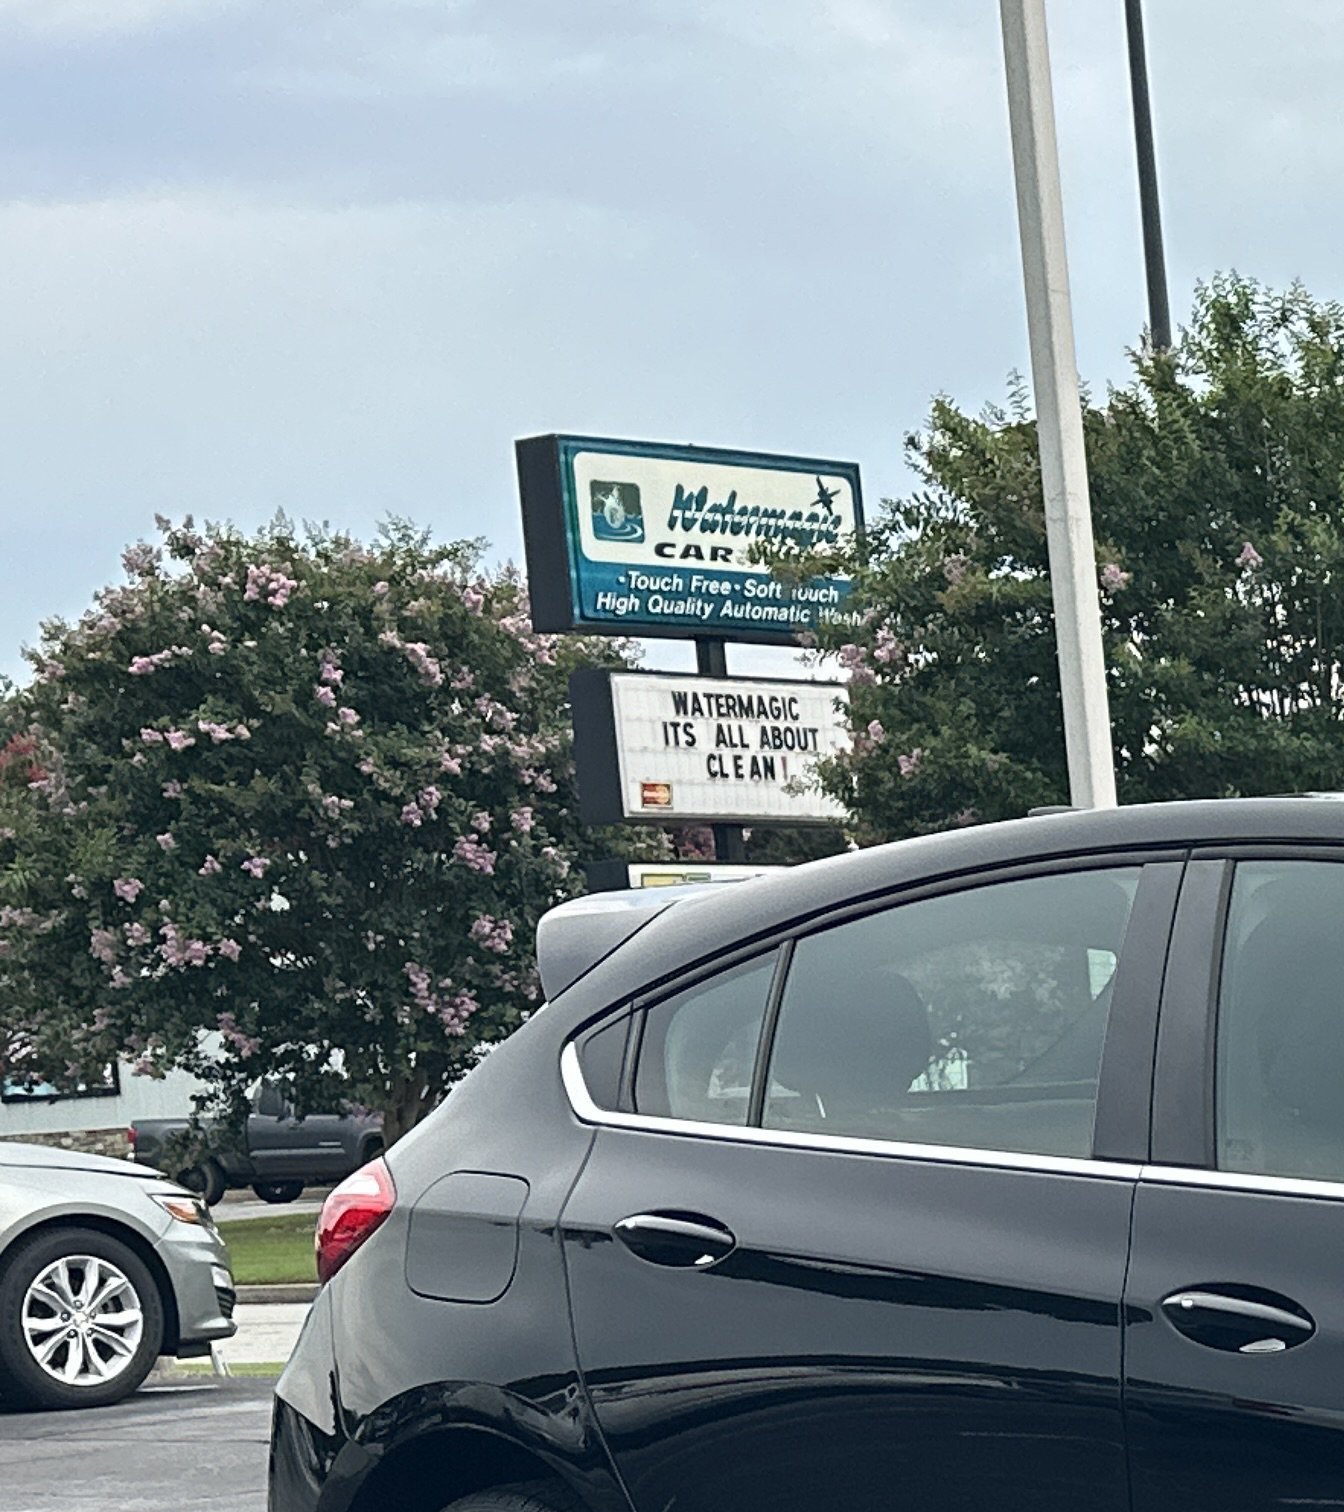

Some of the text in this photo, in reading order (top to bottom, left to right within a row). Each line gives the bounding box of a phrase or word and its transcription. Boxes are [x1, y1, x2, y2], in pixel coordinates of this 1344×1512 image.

[667, 483, 842, 543] Watermagic
[654, 541, 734, 563] CAR
[628, 570, 683, 593] Touch
[743, 578, 782, 600] Soft
[596, 591, 640, 616] High
[647, 594, 714, 620] Quality
[719, 600, 811, 623] Automatic
[671, 690, 800, 721] WATERMAGIC
[662, 721, 819, 751] ITS ALL ABOUT
